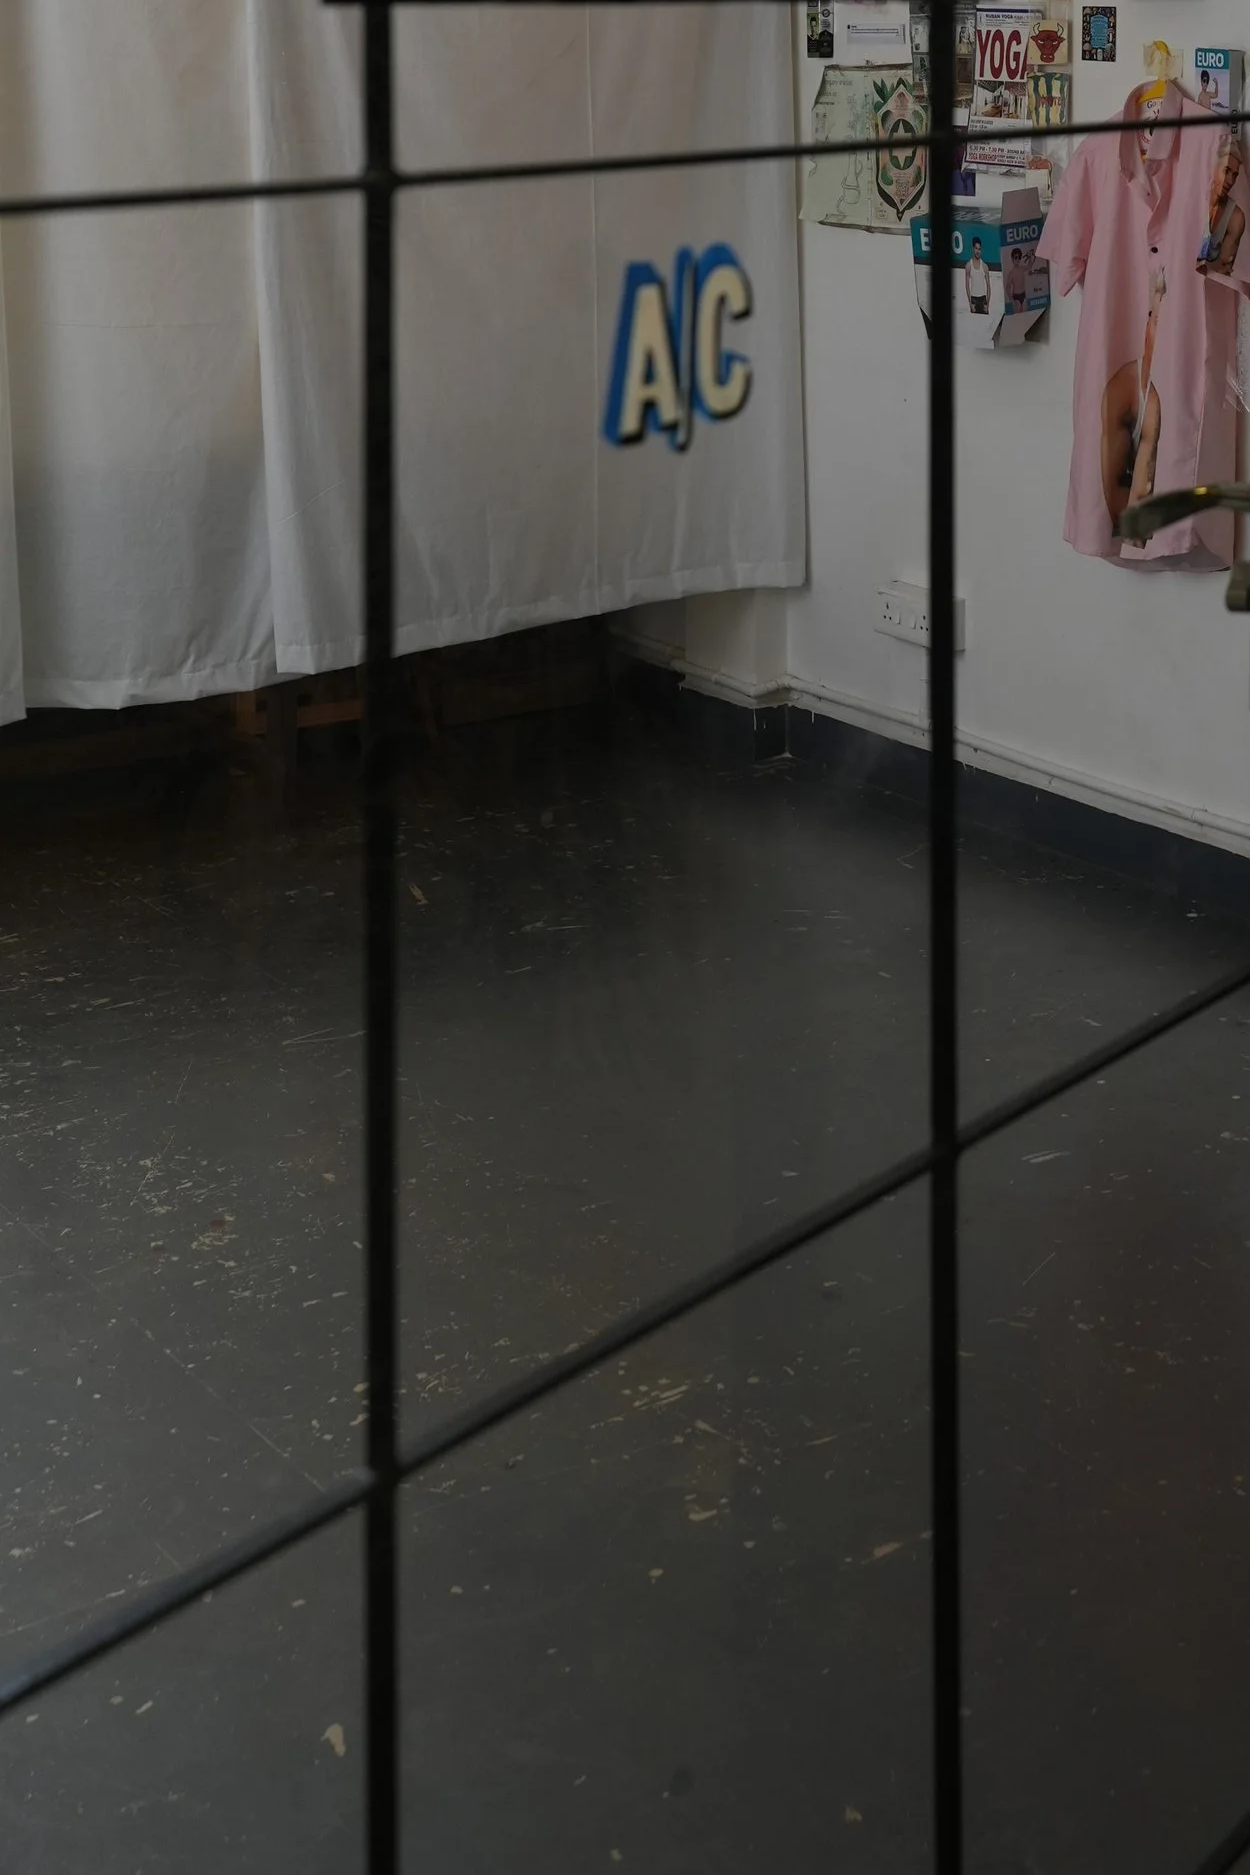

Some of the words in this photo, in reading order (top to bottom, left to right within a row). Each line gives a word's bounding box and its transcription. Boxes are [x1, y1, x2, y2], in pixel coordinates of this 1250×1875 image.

[1197, 51, 1224, 68] EURO
[919, 227, 964, 255] EO
[1005, 224, 1039, 243] EURO
